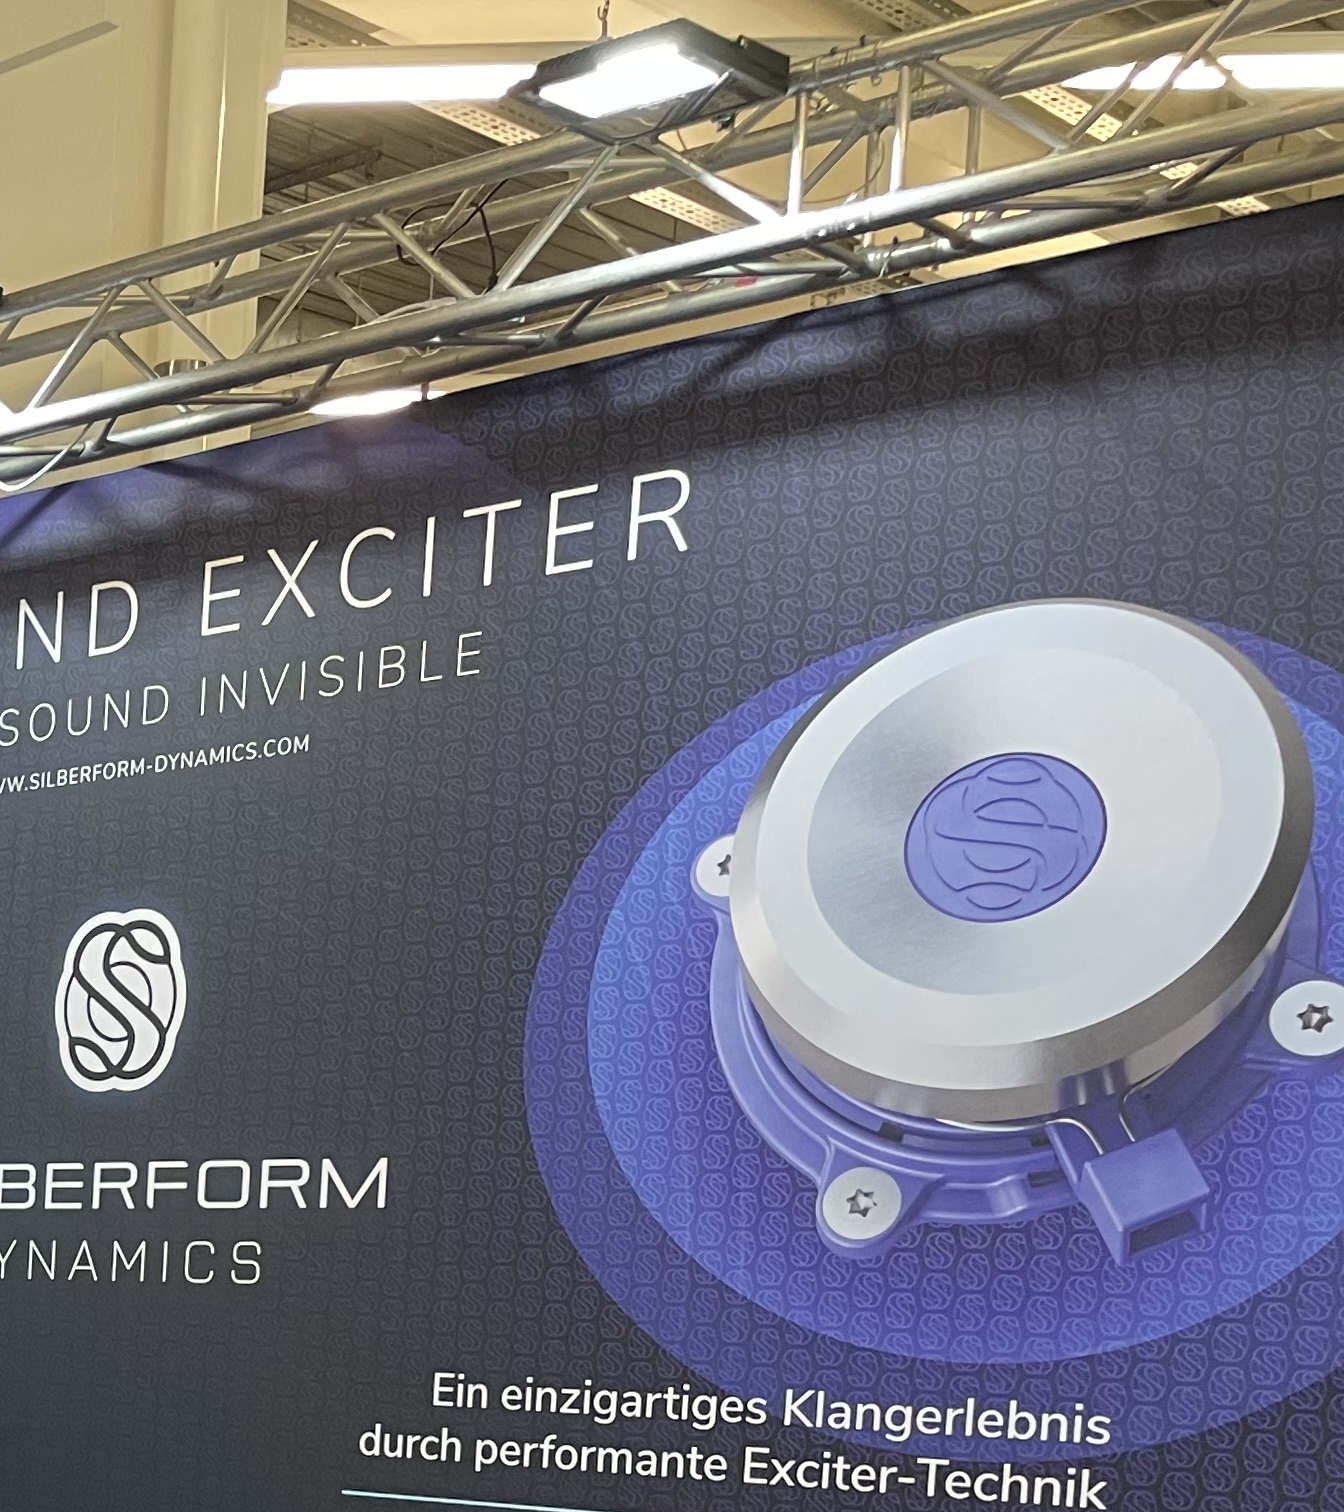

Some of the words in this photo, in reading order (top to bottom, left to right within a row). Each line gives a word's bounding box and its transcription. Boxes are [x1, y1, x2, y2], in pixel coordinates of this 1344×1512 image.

[199, 469, 692, 636] EXCITER
[199, 631, 484, 718] INVISIBLE
[431, 1372, 489, 1410] Ein
[500, 1376, 768, 1431] einzigartiges
[783, 1388, 1112, 1446] Klangerlebnis
[358, 1423, 462, 1463] durch
[474, 1427, 728, 1483] performante
[742, 1447, 1108, 1511] Exciter-Technik
